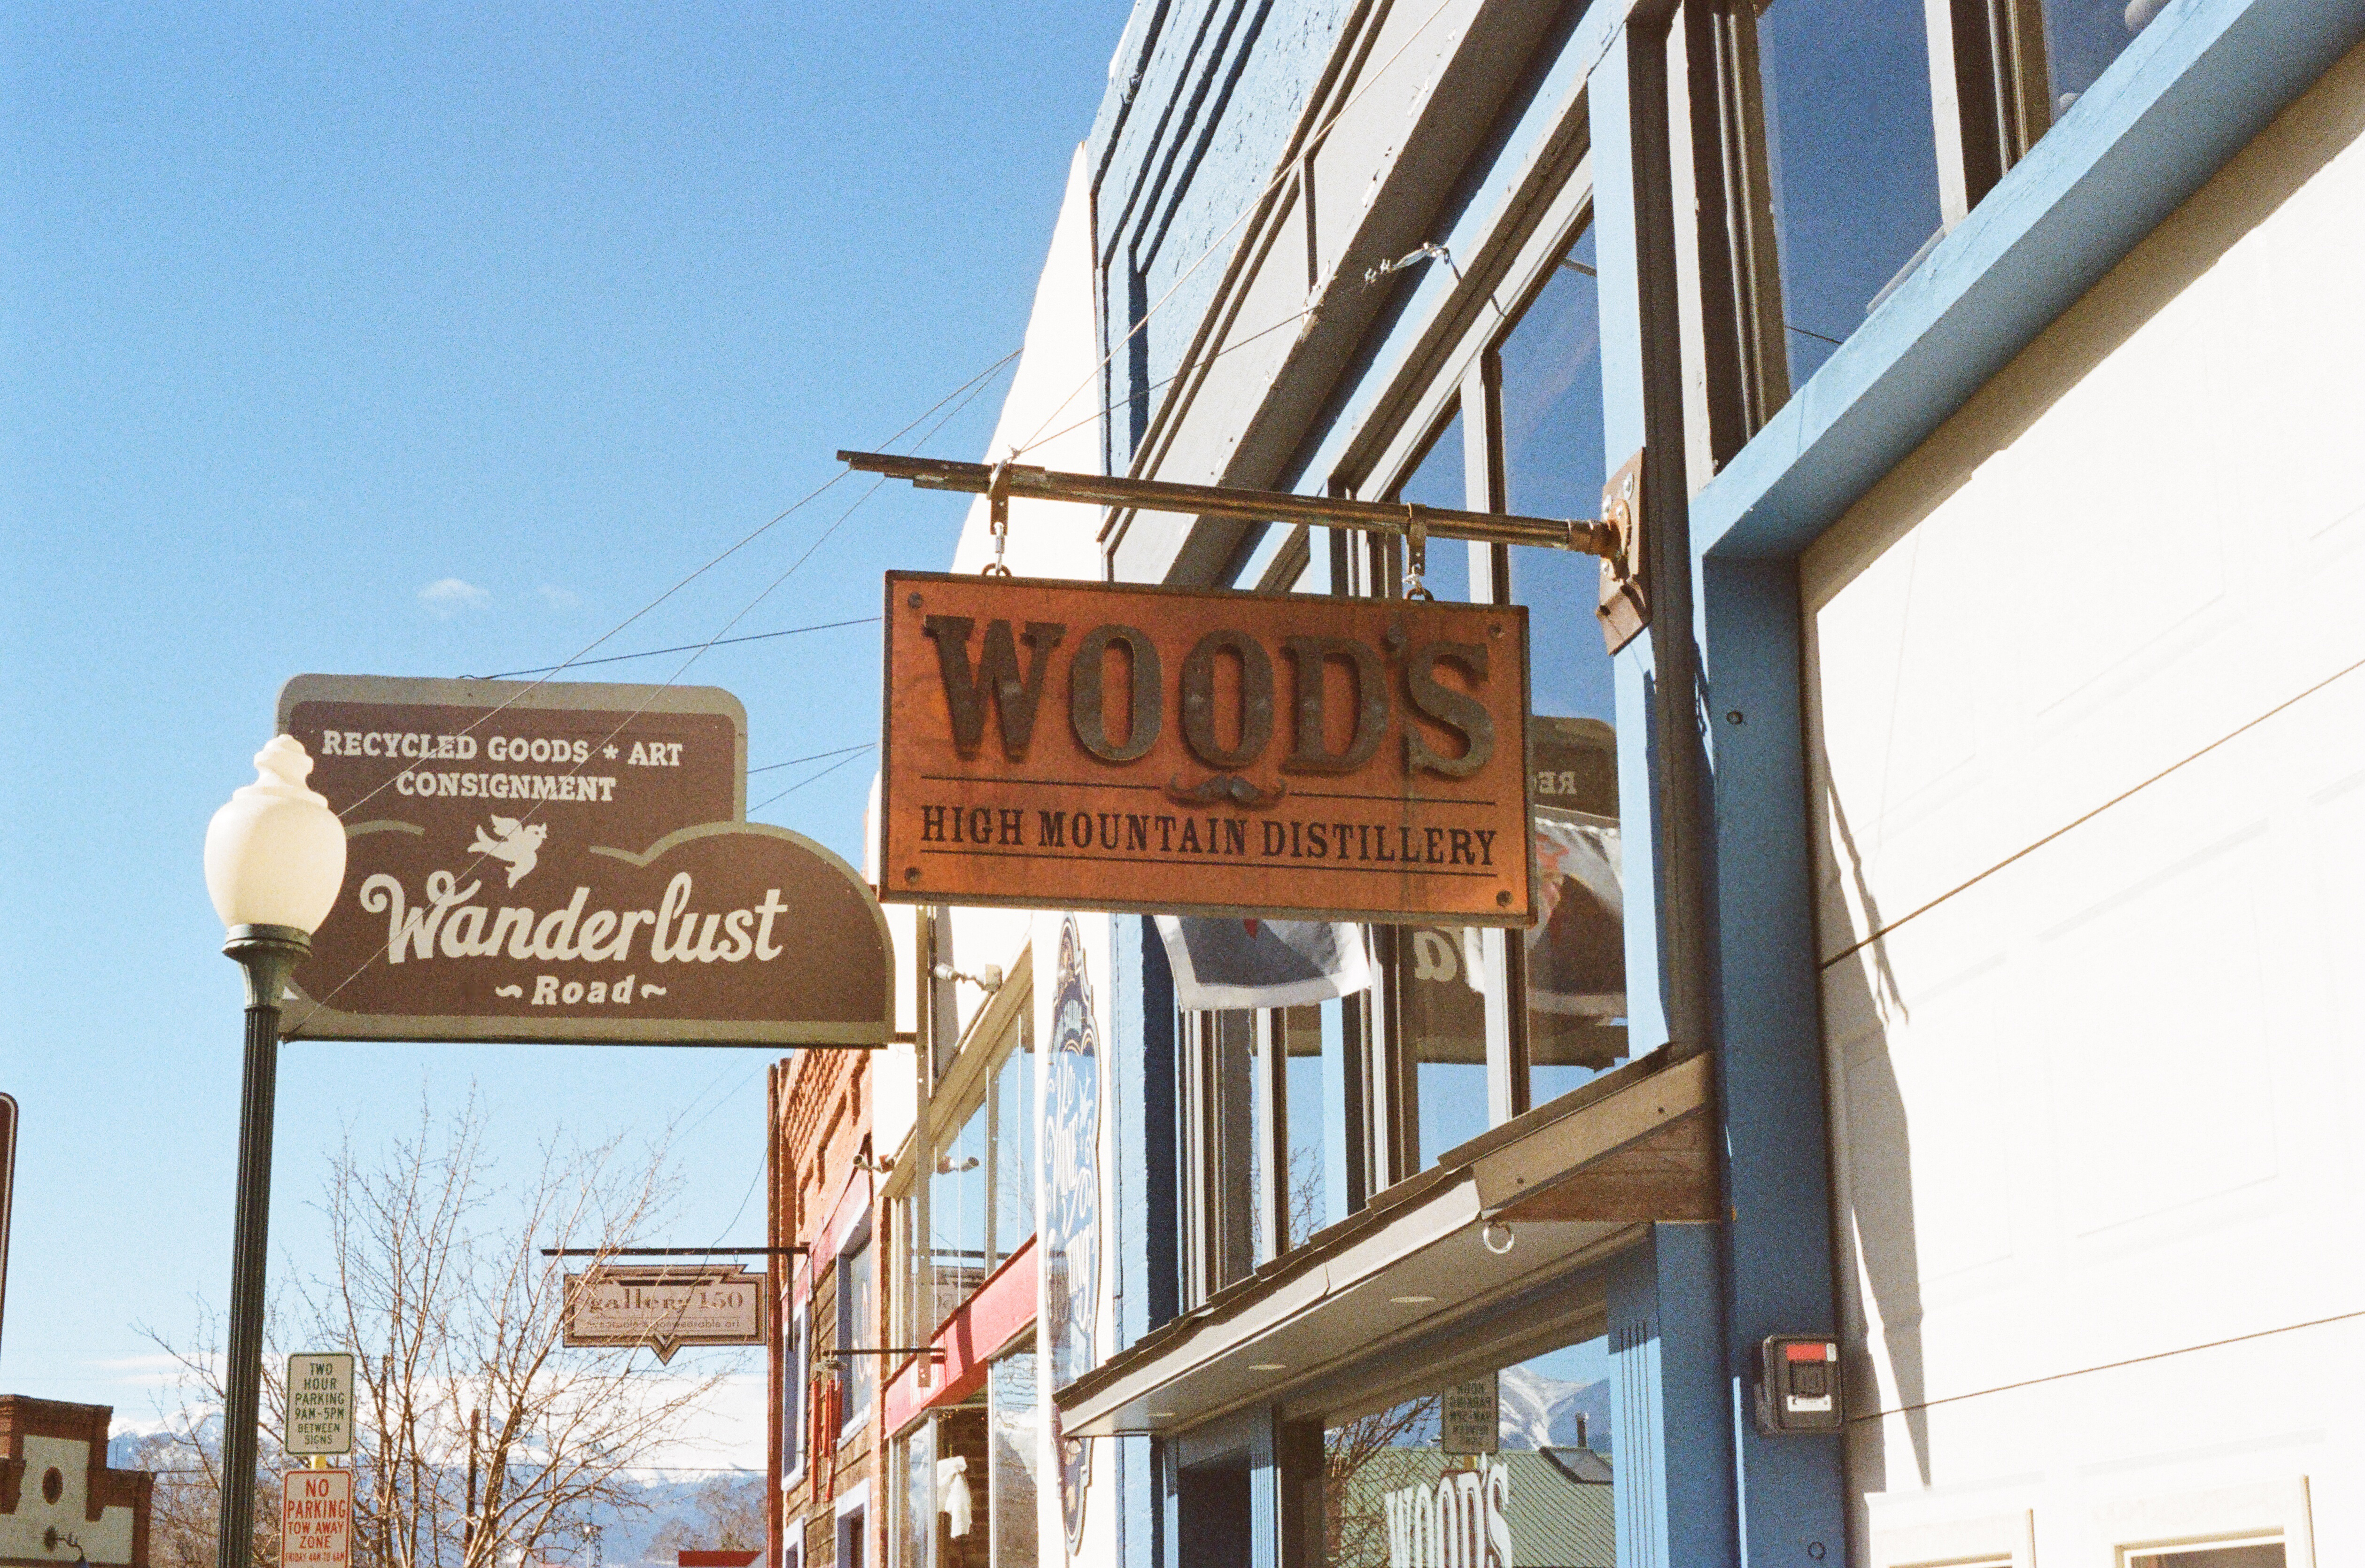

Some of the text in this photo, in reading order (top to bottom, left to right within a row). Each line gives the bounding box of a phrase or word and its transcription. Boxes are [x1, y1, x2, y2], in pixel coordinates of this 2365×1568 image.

[322, 729, 683, 766] RECYCLED GOODS ART
[396, 771, 617, 802] CONSIGNMENT
[921, 804, 1497, 865] HIGH MOUNTAIN DISTILLERY
[359, 871, 789, 964] Wanderlust
[530, 973, 636, 1005] Road
[699, 1291, 744, 1309] 150
[310, 1362, 333, 1375] TWO
[304, 1377, 337, 1390] HOUR
[295, 1392, 345, 1405] PARKING
[298, 1423, 340, 1433] BETWEEN
[304, 1435, 333, 1444] SIGNS
[306, 1478, 329, 1498] NO
[287, 1498, 346, 1519] PARKING
[287, 1521, 344, 1534] TOW AWAY
[299, 1535, 331, 1549] ZONE
